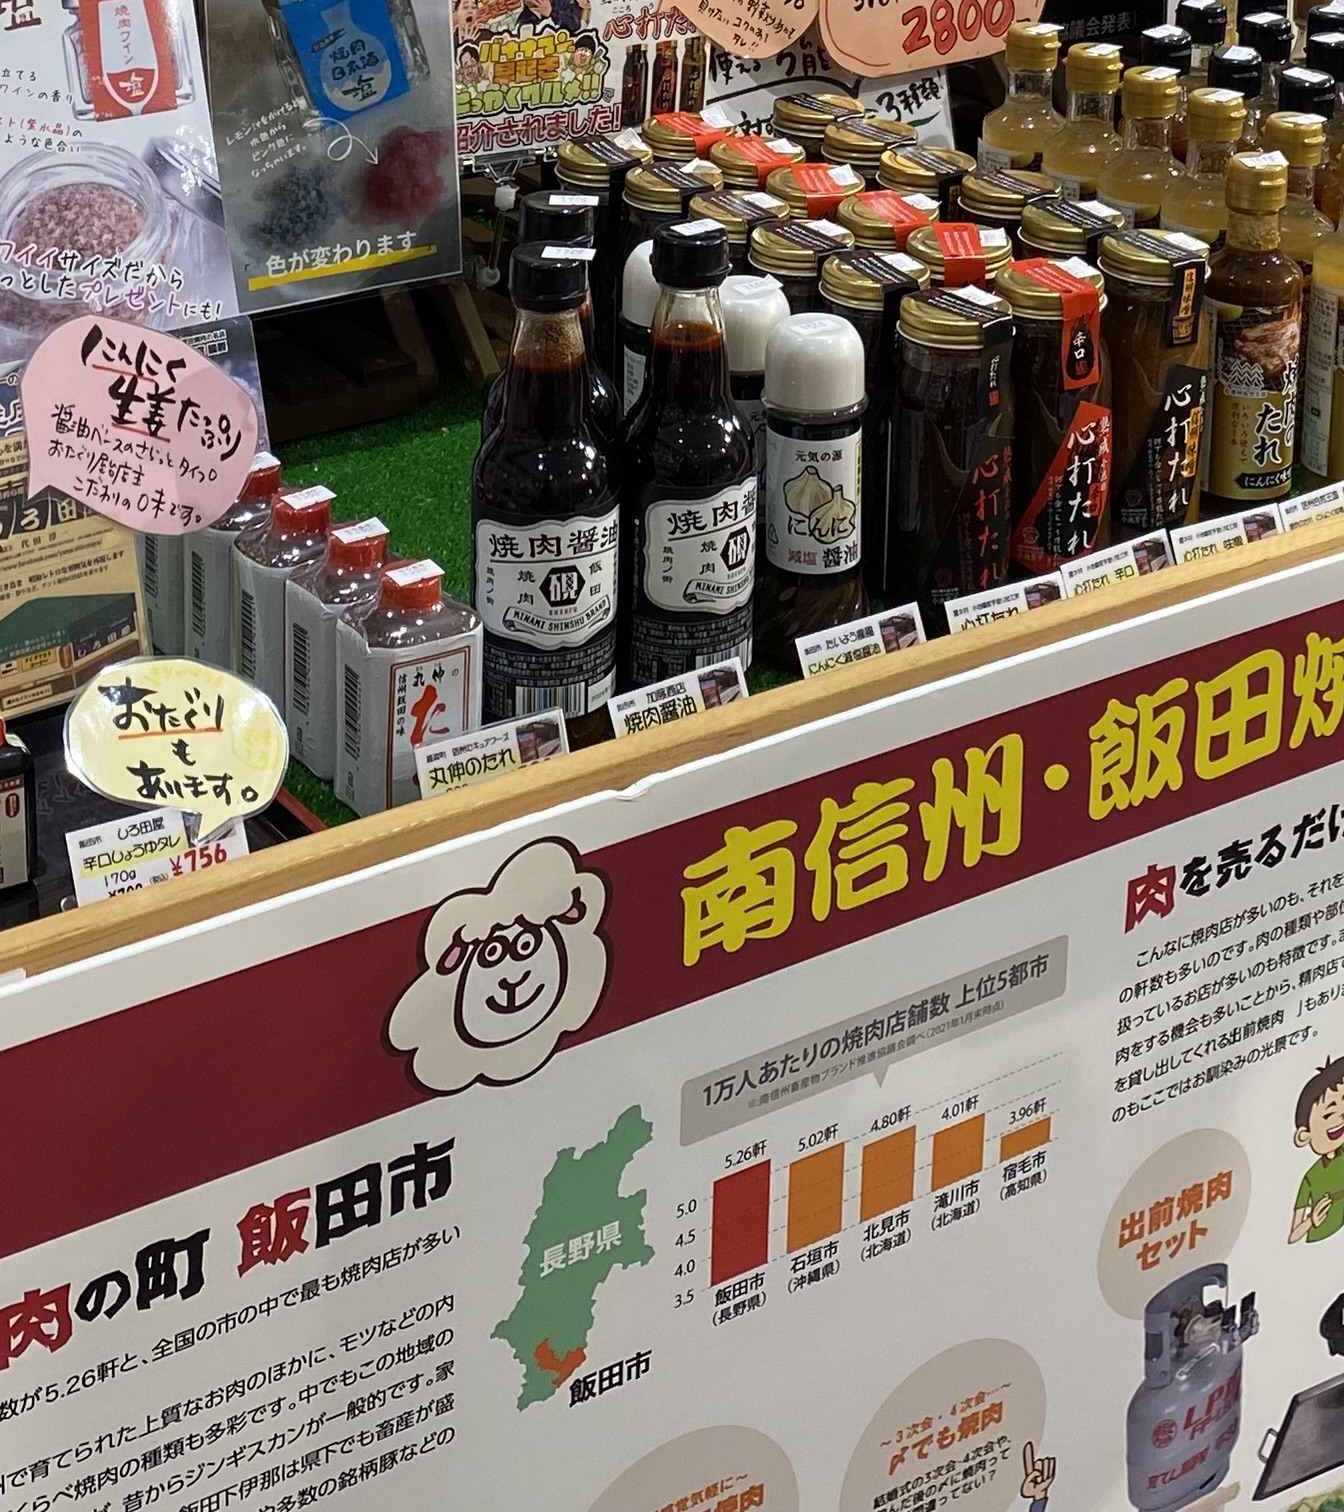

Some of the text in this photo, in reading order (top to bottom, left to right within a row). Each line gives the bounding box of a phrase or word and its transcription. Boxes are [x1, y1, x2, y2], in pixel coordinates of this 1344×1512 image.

[265, 229, 419, 279] 色が変わります
[81, 323, 186, 381] にんにく
[794, 449, 843, 464] 元気の源
[98, 677, 225, 733] おたぐり
[624, 693, 698, 733] 焼肉醤油
[171, 739, 196, 767] も
[125, 762, 259, 806] あります。
[82, 834, 180, 871] 辛口しょうゆタレ
[169, 842, 229, 879] ¥756
[700, 952, 1050, 1109] 1万人あたりの焼肉店舗数 上位5都市
[1111, 1025, 1320, 1124] のもここではお馴染みの光景です。
[869, 1103, 913, 1136] 4.80軒
[940, 1093, 981, 1122] 4.01軒
[1008, 1097, 1048, 1126] 3.96軒
[722, 1138, 768, 1170] 5.26軒
[796, 1121, 840, 1153] 5.02軒
[998, 1167, 1049, 1204] (高知県)
[1001, 1151, 1047, 1184] 宿毛市
[235, 1137, 457, 1278] 飯田市
[676, 1197, 698, 1217] 5.0
[929, 1194, 982, 1233] (北海道)
[933, 1178, 980, 1212] 滝川市
[1117, 1169, 1234, 1250] 出前焼肉
[676, 1227, 697, 1247] 4.5
[859, 1224, 913, 1264] (北海道)
[862, 1208, 911, 1243] 北見市
[538, 1219, 624, 1278] 長野県
[789, 1240, 840, 1276] 石垣市
[1135, 1218, 1209, 1272] セット
[674, 1257, 696, 1278] 4.0
[786, 1256, 843, 1296] (沖縄県)
[673, 1287, 695, 1308] 3.5
[714, 1271, 766, 1308] 飯田市
[710, 1289, 768, 1328] (長野県)
[568, 1348, 654, 1408] 飯田市
